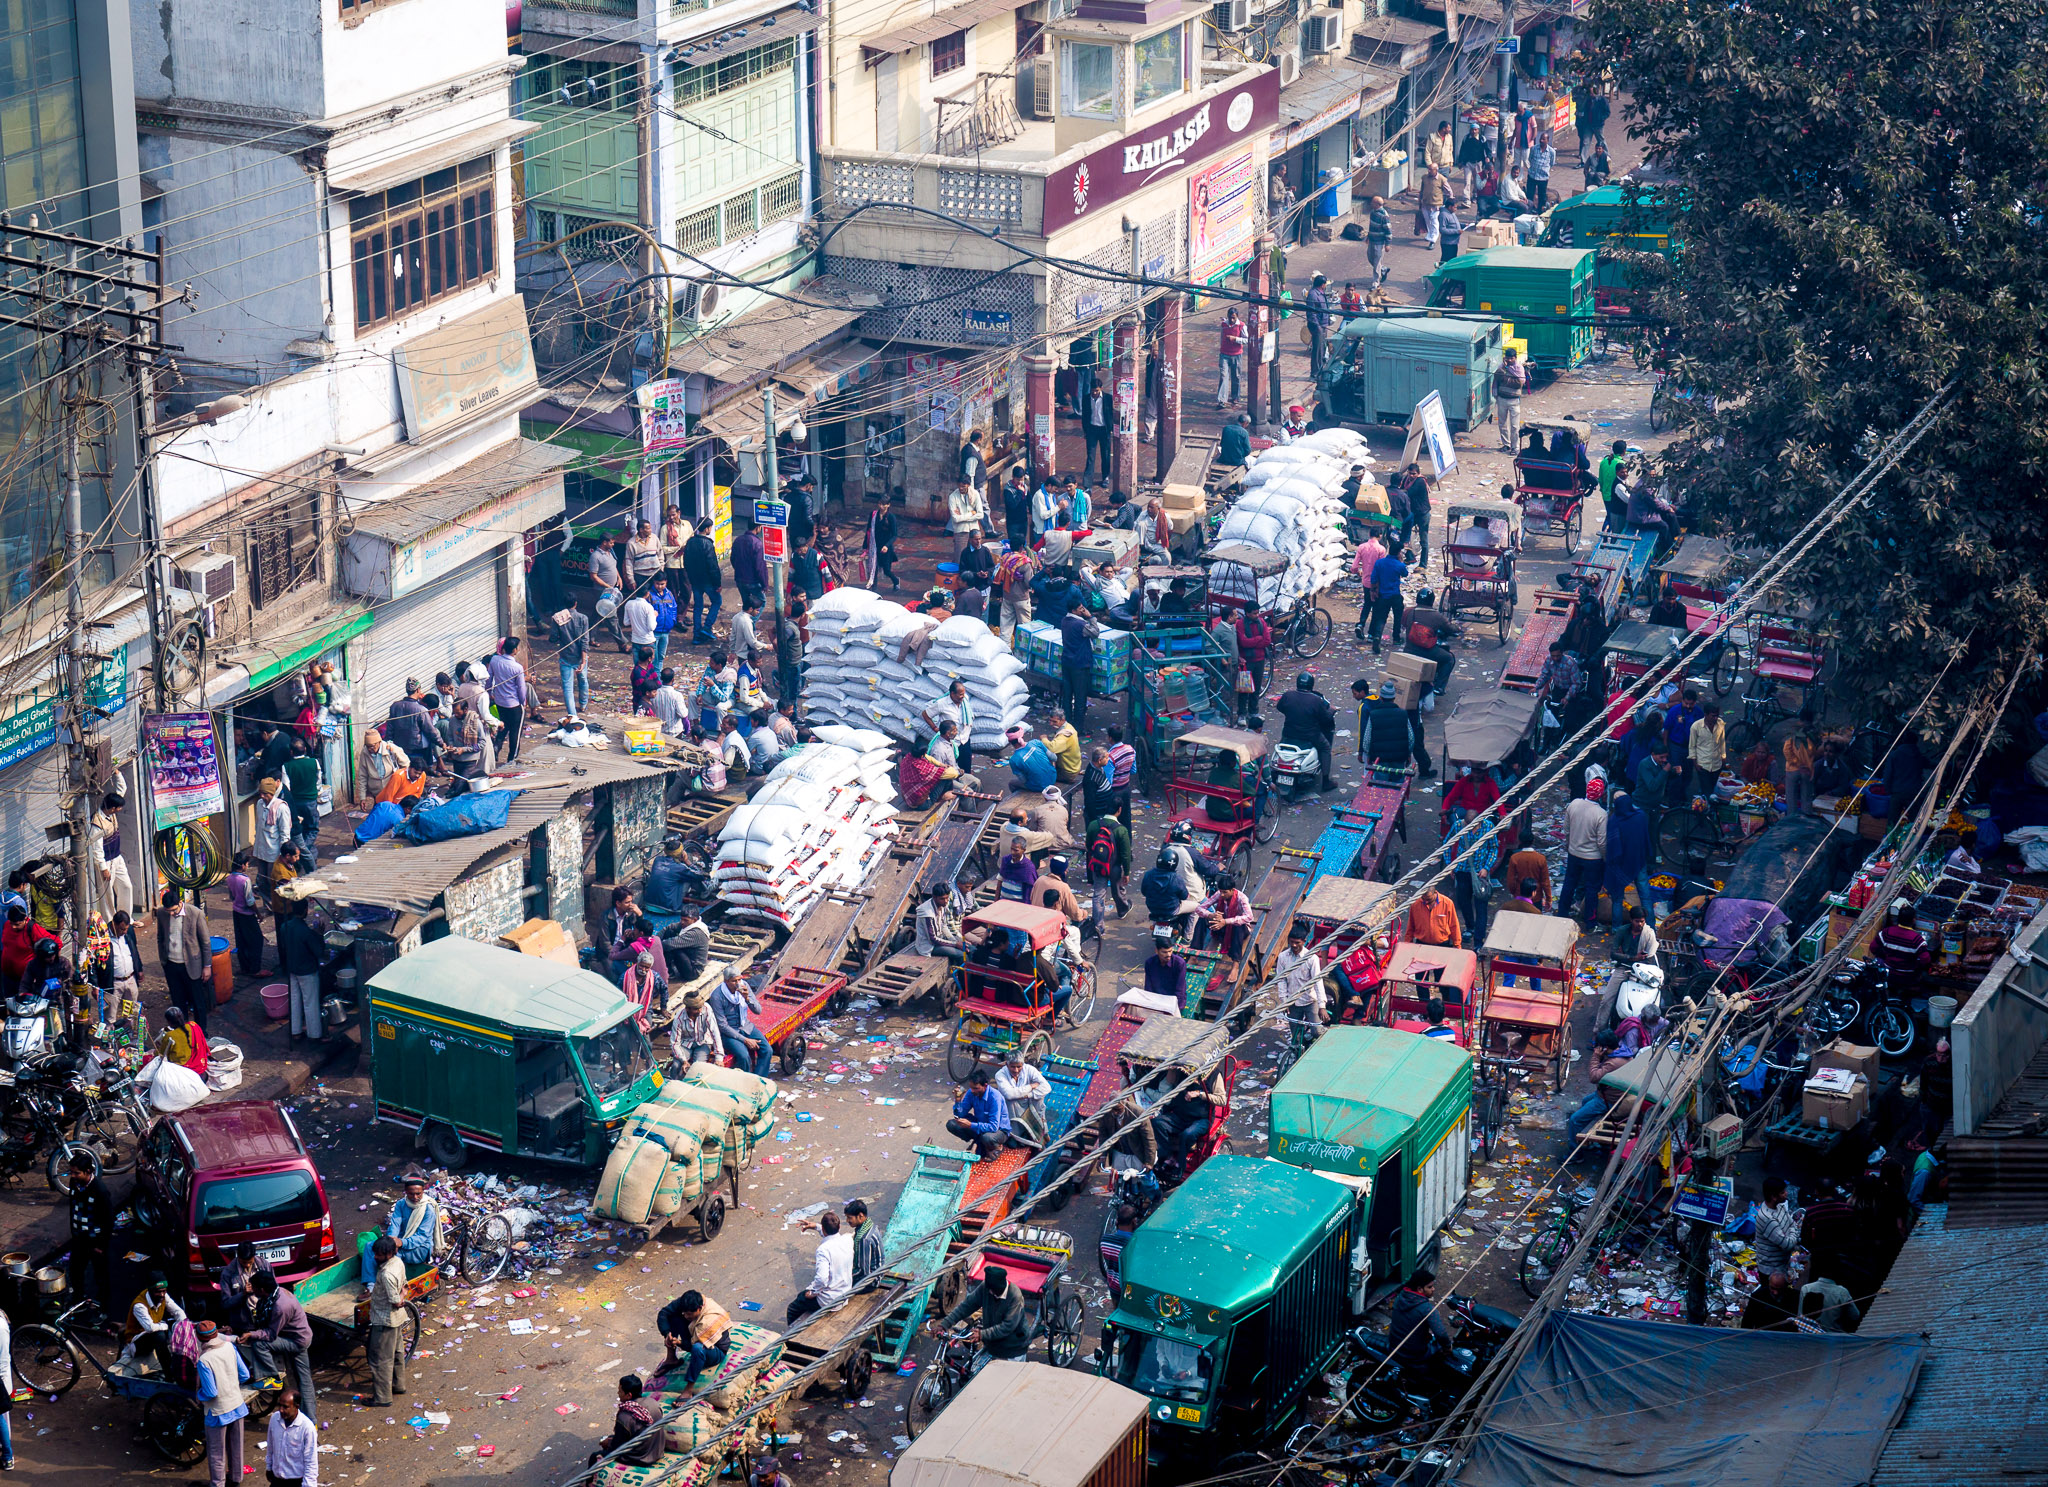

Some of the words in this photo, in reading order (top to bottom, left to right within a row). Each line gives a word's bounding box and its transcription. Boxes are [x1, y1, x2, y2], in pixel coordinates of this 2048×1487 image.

[1122, 102, 1211, 174] KAILASH
[964, 317, 1011, 332] KAILASH
[460, 351, 488, 372] ANOOP
[459, 394, 477, 412] Silver
[478, 386, 499, 404] Leaves
[580, 437, 591, 447] life
[13, 714, 29, 730] Desi
[30, 705, 51, 720] Ghee,
[21, 726, 33, 739] Oil,
[34, 719, 47, 732] Dry
[0, 752, 16, 766] Khari
[16, 743, 33, 758] Baoli,
[429, 1039, 446, 1050] CNG
[1719, 1122, 1740, 1140] DEN
[1290, 1141, 1307, 1154] जय
[270, 1250, 286, 1259] 6110
